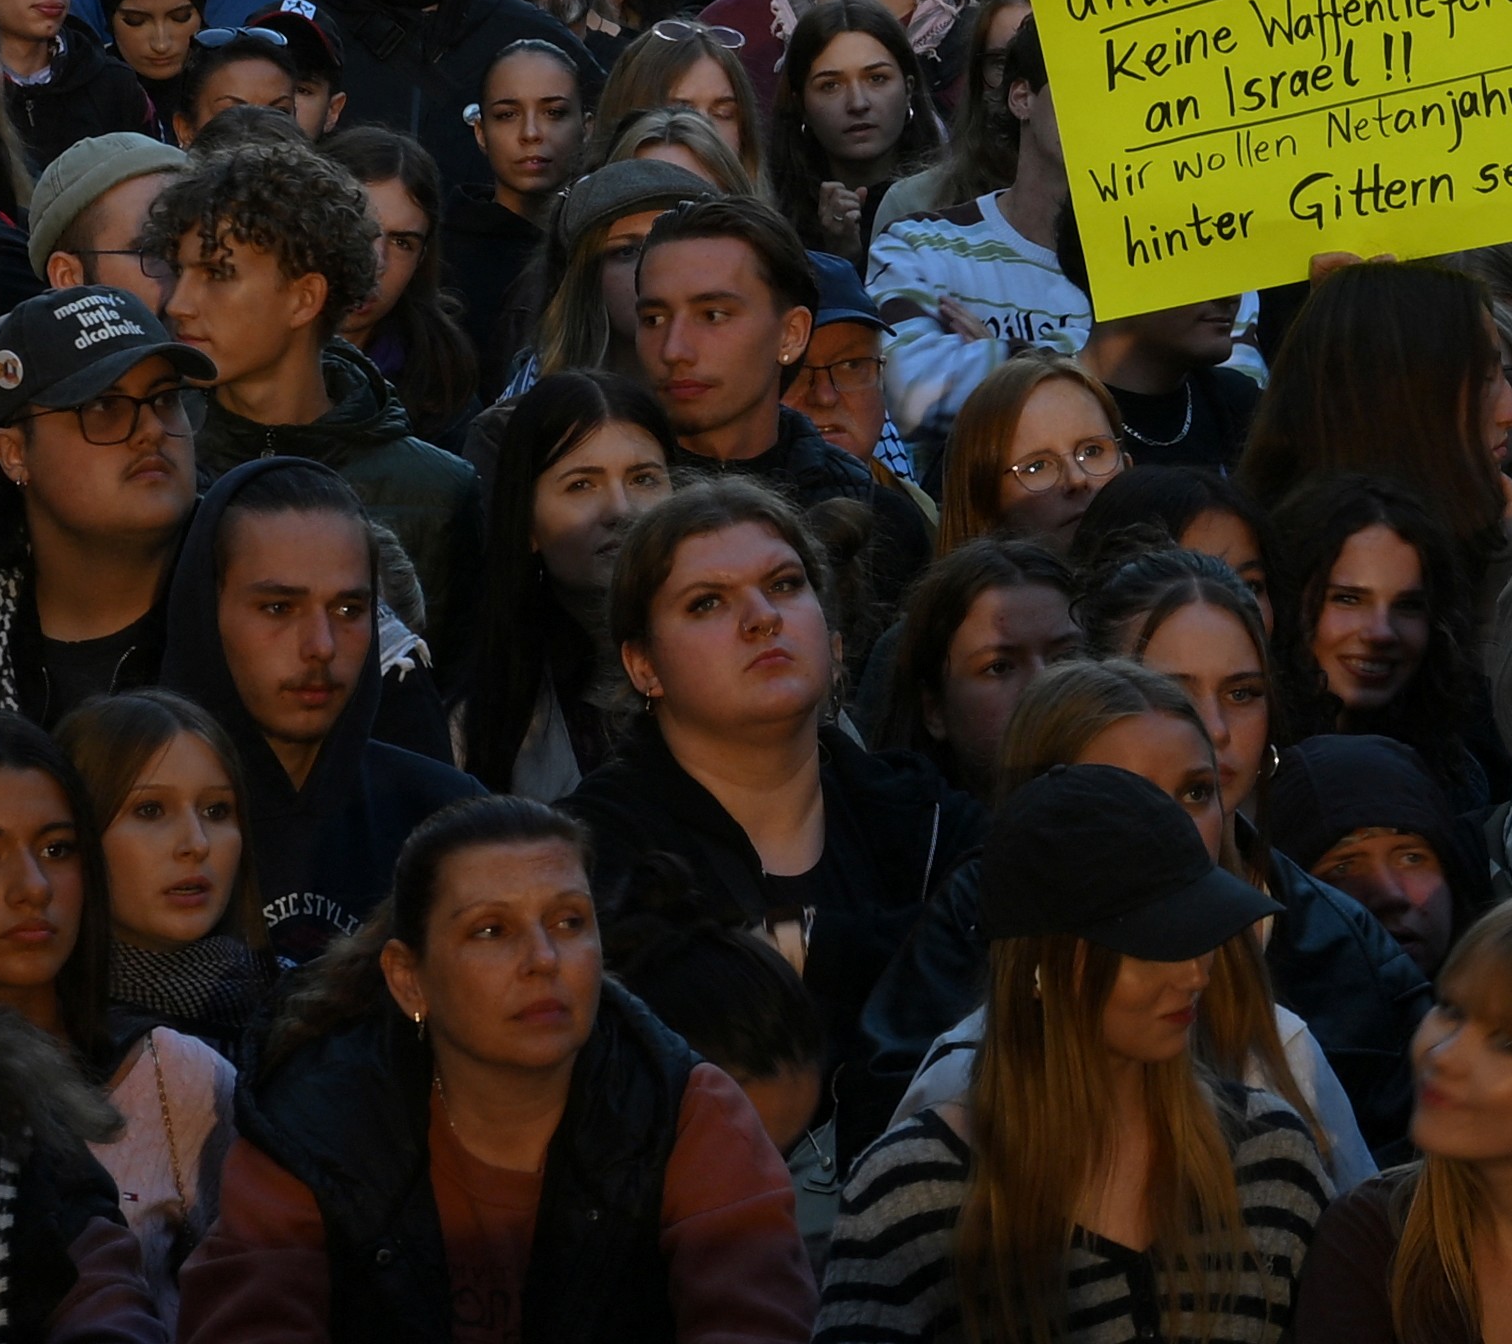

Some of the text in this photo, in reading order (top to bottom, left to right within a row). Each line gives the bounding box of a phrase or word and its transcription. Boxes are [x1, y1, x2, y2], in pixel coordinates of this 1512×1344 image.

[1145, 30, 1415, 135] an Israel !!
[1089, 159, 1147, 204] Wir
[1174, 128, 1298, 184] wollen
[1125, 202, 1255, 268] hinter
[1288, 163, 1454, 231] Gittern
[74, 318, 146, 350] alcoholic
[75, 305, 121, 329] little
